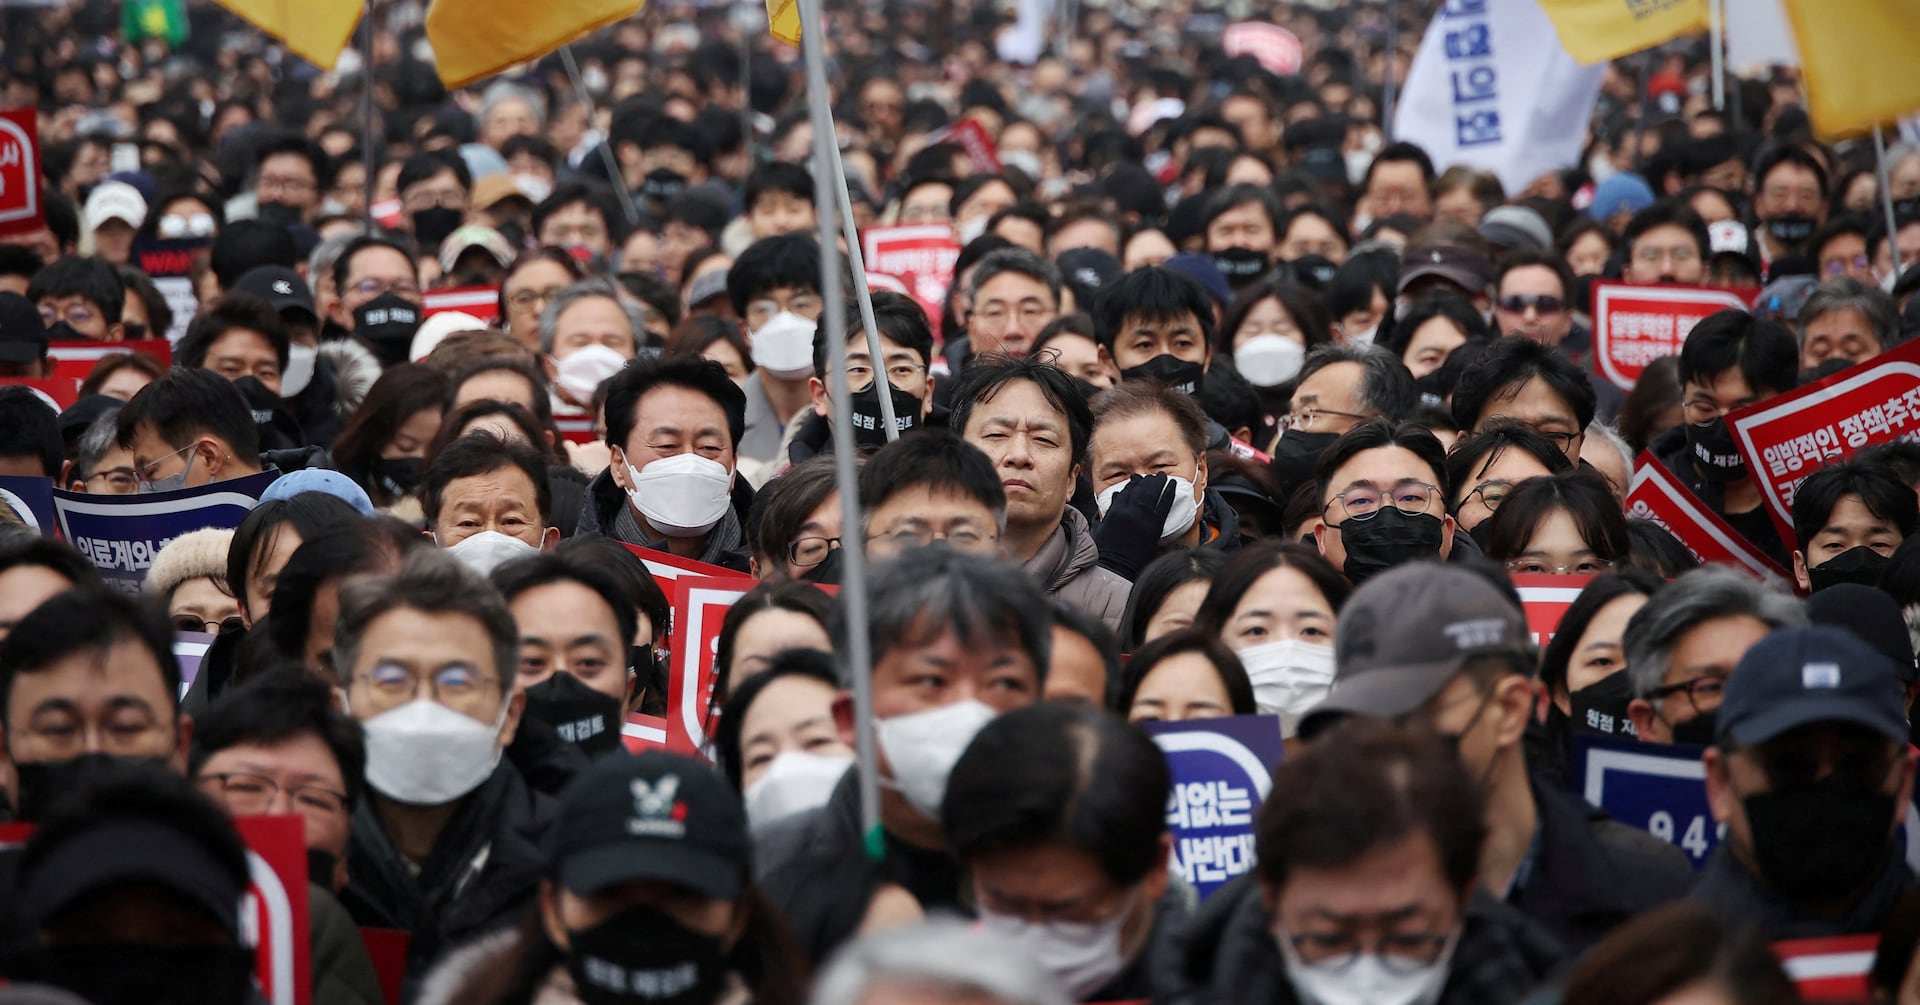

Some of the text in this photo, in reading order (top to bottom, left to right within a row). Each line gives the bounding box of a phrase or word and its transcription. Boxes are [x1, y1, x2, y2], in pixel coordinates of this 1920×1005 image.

[853, 411, 876, 431] 원점
[1763, 382, 1920, 478] 일방적인 정책추진
[77, 536, 157, 572] 의료계와
[1586, 708, 1614, 734] 원점
